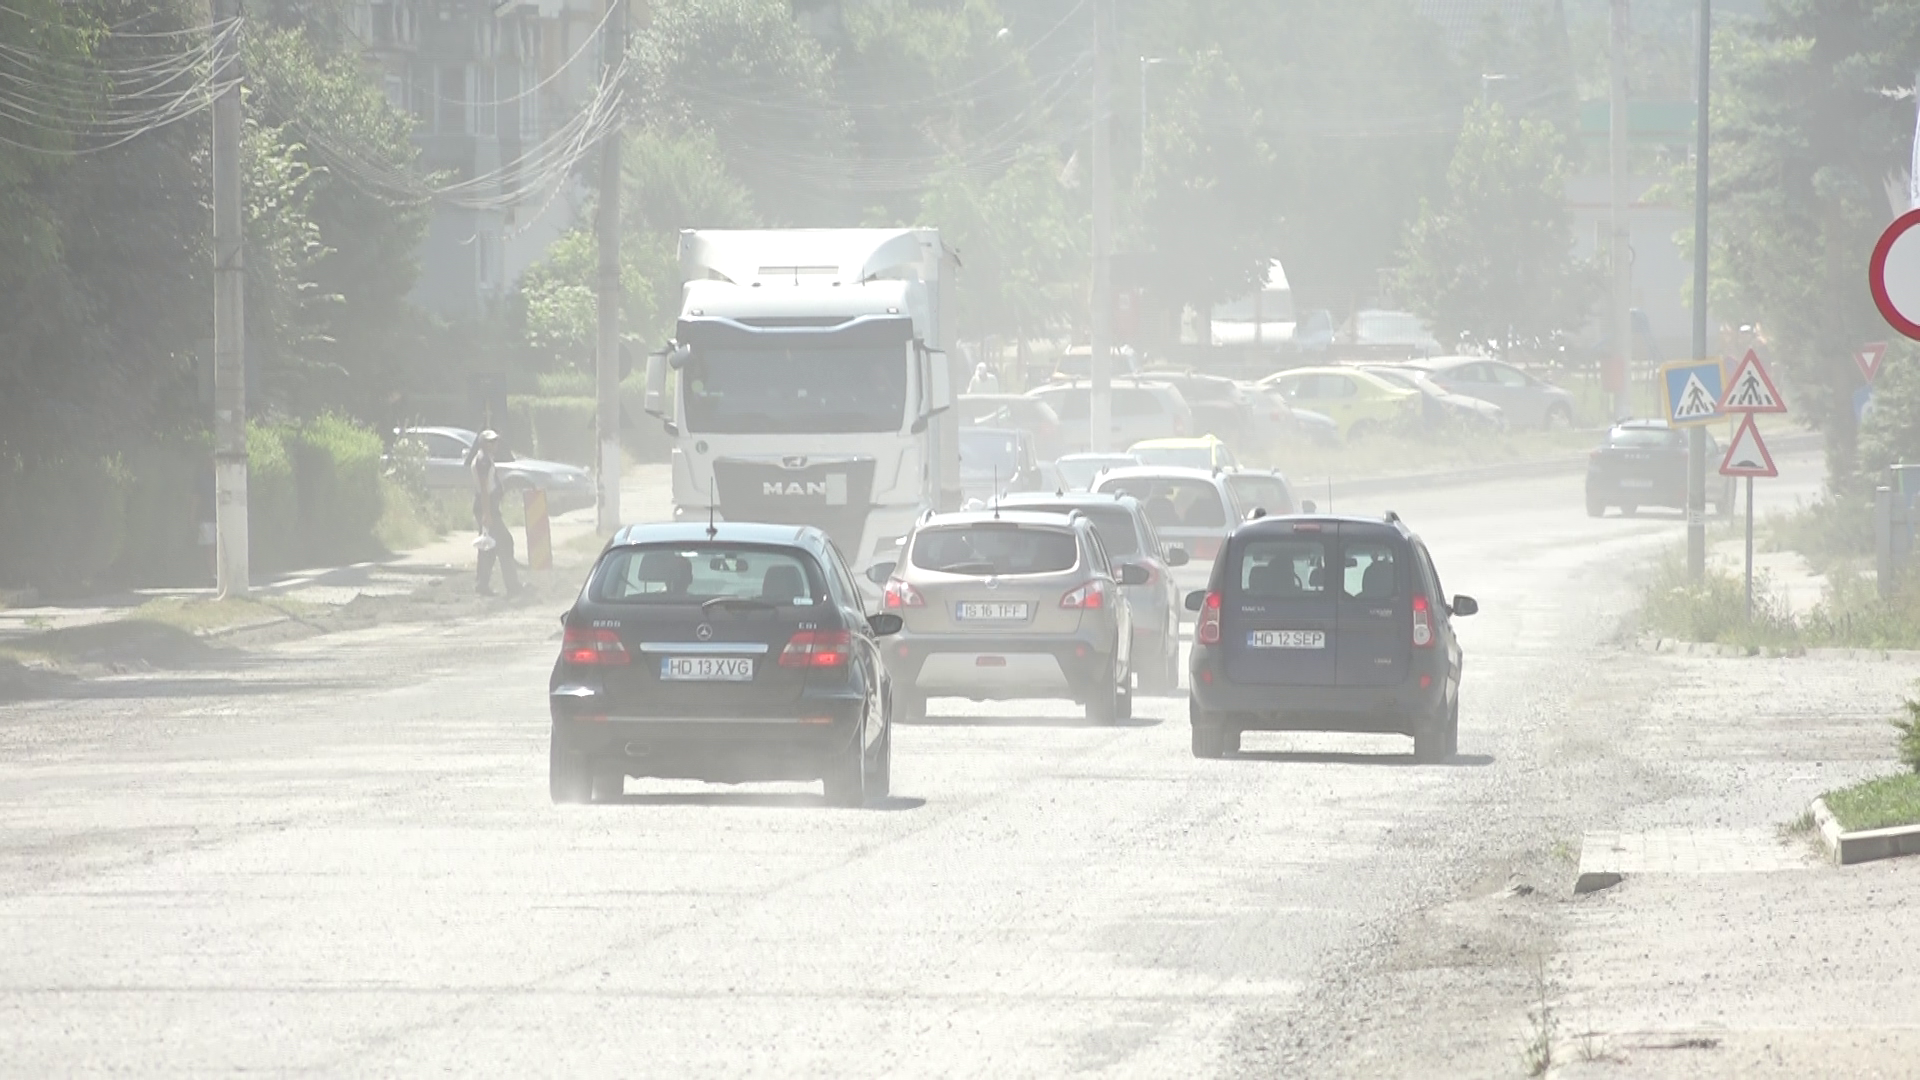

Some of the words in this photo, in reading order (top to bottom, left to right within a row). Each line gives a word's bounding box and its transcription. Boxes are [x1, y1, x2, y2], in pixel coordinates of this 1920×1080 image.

[762, 481, 826, 496] MAN
[965, 604, 976, 617] IS
[982, 604, 992, 617] 16
[1254, 632, 1273, 646] HD
[1278, 632, 1289, 646] 12
[1293, 632, 1322, 646] SEP
[670, 660, 692, 675] HD
[697, 660, 712, 675] 13
[715, 660, 749, 675] XVG
